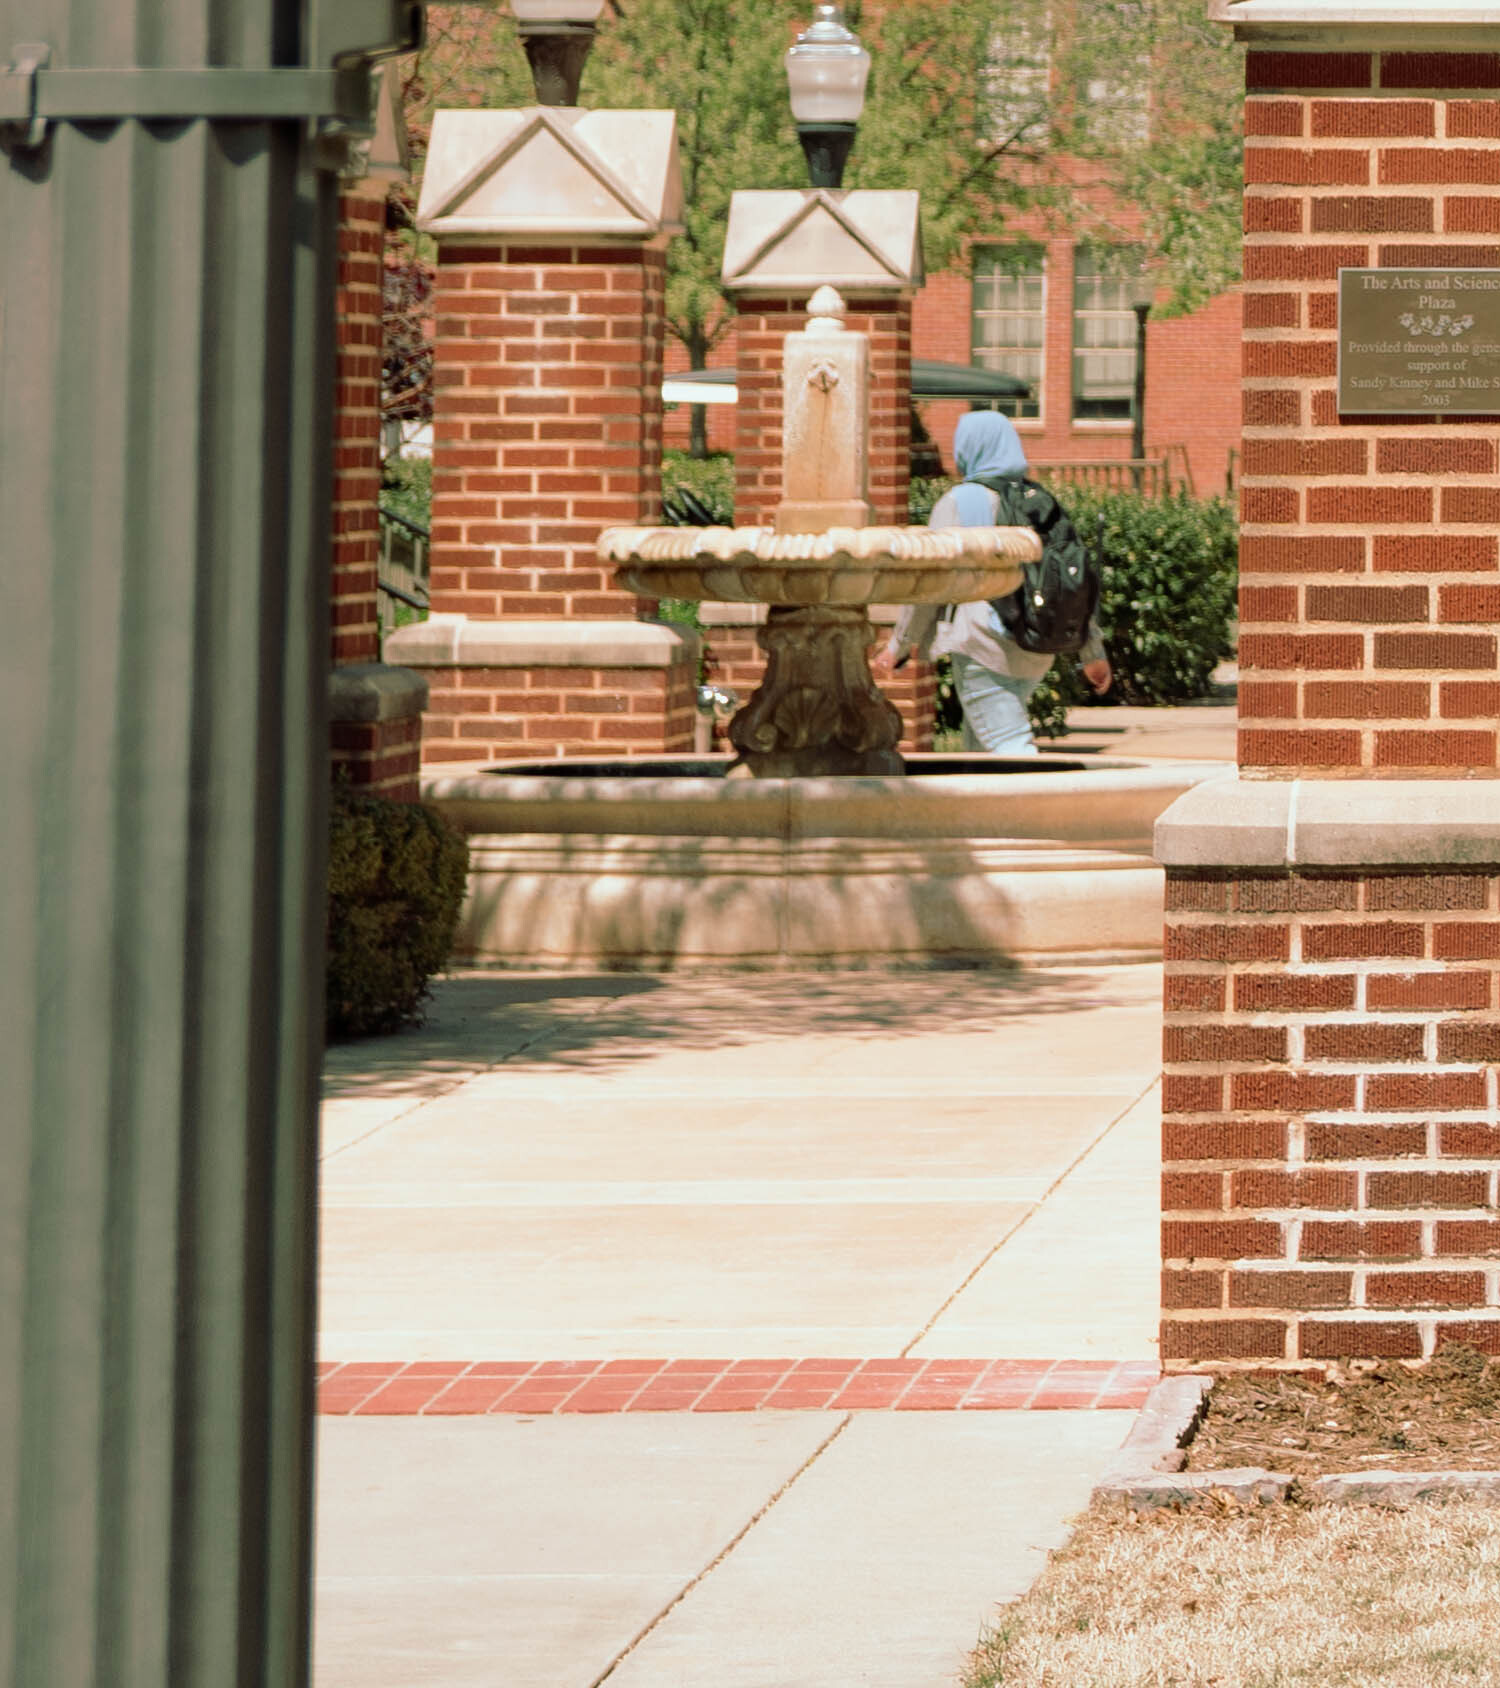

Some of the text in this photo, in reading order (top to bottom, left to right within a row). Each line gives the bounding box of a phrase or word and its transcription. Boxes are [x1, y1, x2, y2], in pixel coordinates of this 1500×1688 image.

[1361, 276, 1387, 290] The
[1391, 276, 1421, 290] Arts
[1425, 276, 1450, 290] and
[1418, 295, 1456, 310] Plaza
[1349, 341, 1401, 353] Provided
[1403, 342, 1449, 356] through
[1451, 342, 1470, 353] the
[1407, 359, 1467, 374] support of
[1351, 377, 1385, 390] Sandy
[1390, 377, 1431, 391] Kinney
[1435, 377, 1456, 389] and
[1459, 377, 1489, 389] Mike
